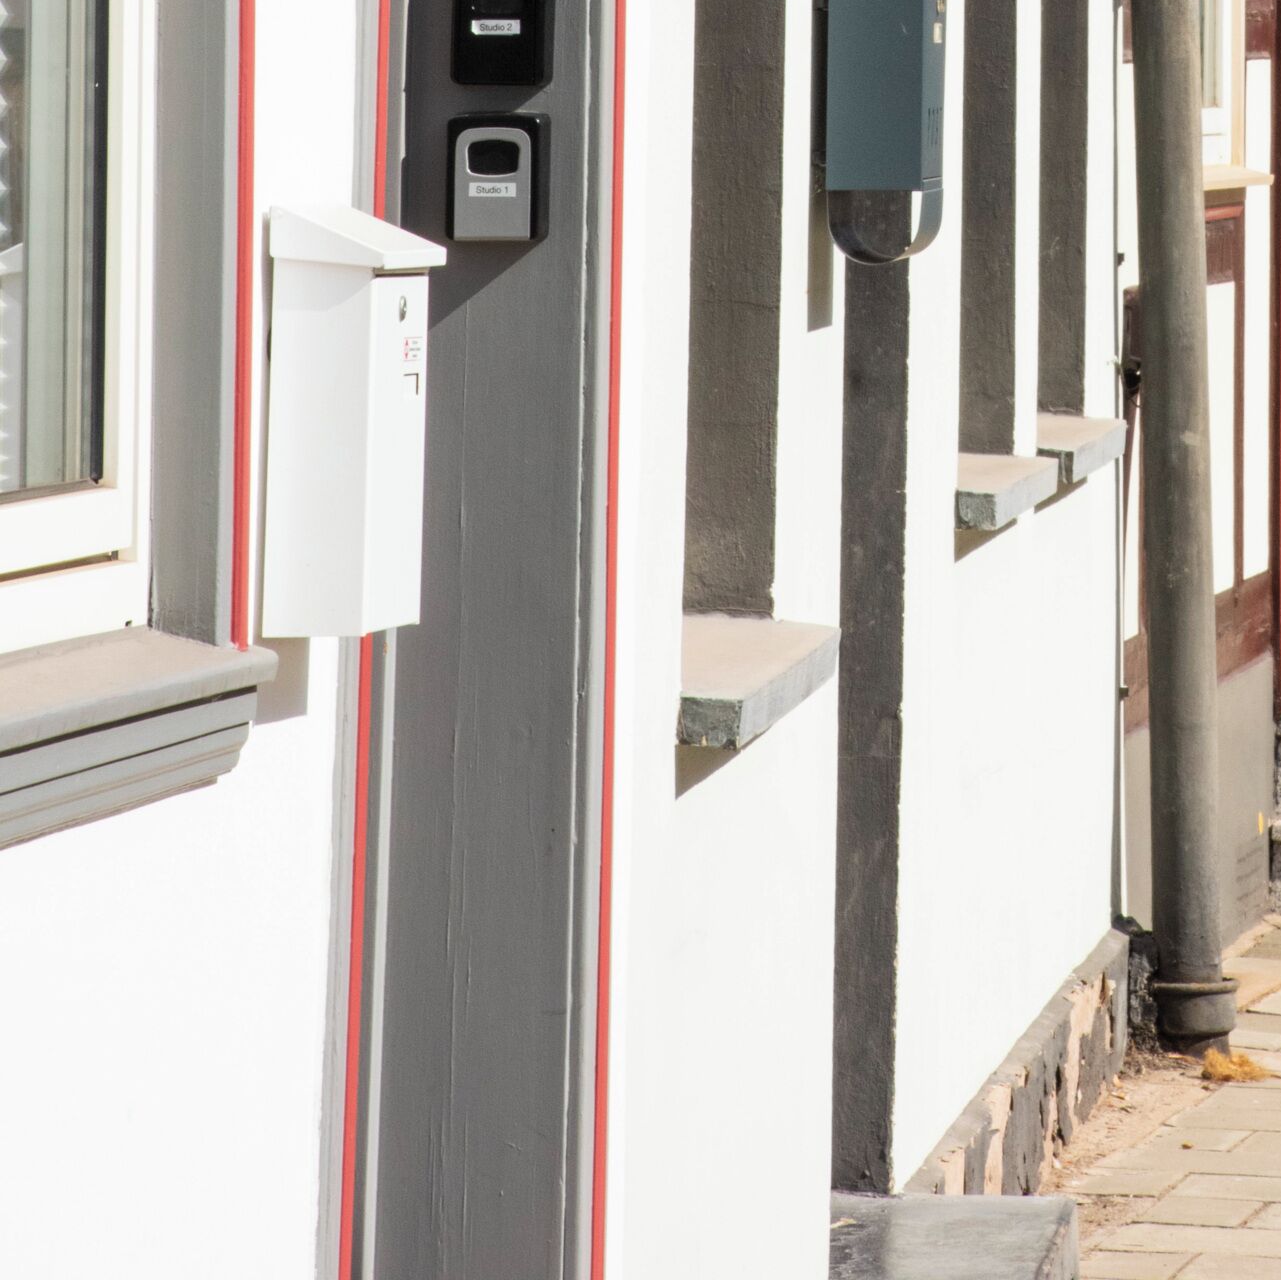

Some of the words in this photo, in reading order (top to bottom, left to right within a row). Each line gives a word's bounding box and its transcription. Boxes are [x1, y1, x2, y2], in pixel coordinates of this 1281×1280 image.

[479, 23, 506, 32] Studio
[506, 23, 513, 32] 2
[475, 184, 502, 194] Studio
